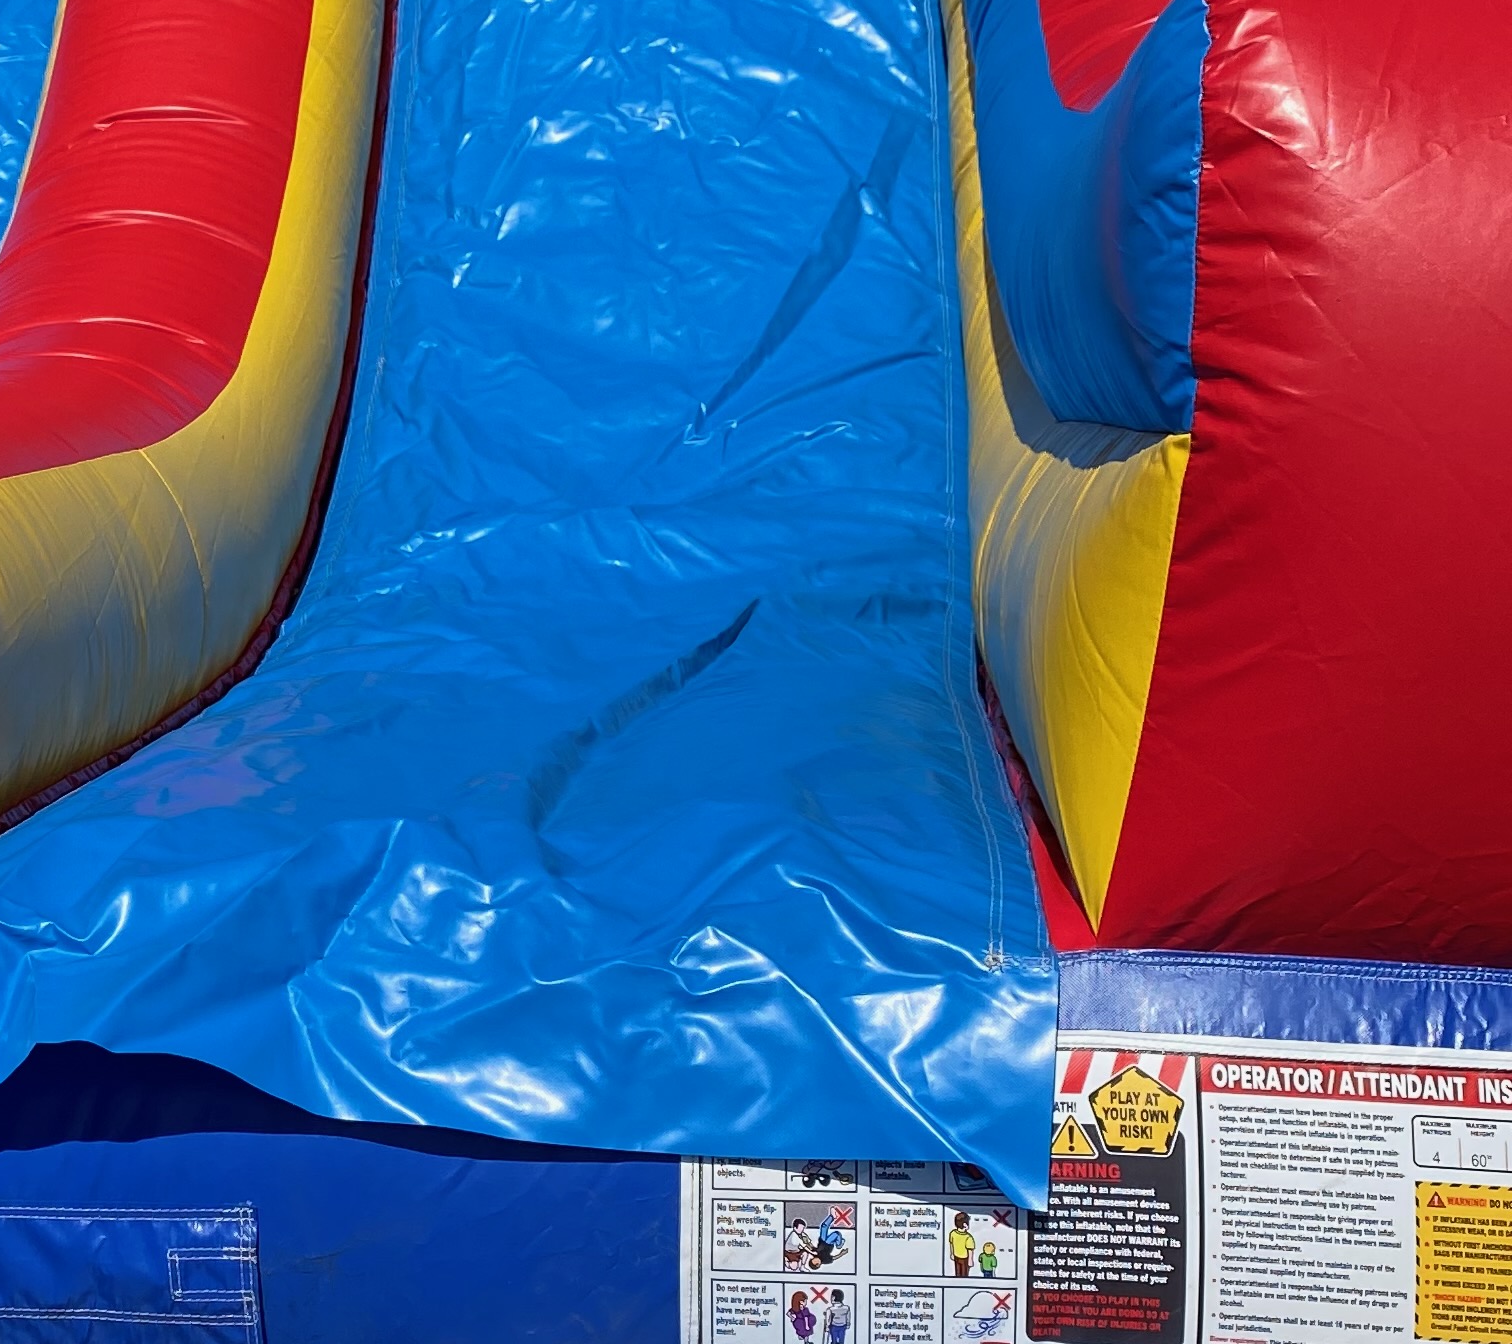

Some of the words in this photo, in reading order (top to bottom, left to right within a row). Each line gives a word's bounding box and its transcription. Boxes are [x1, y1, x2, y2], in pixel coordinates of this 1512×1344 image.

[1211, 1063, 1323, 1093] OPERATOR
[1340, 1070, 1466, 1101] ATTENDANT
[1110, 1091, 1140, 1105] PLAY
[1145, 1094, 1160, 1106] AT
[1054, 1102, 1077, 1112] ATH!
[1102, 1108, 1137, 1121] YOUR
[1141, 1109, 1169, 1123] OWN
[1120, 1125, 1153, 1139] RISK!
[1433, 1152, 1440, 1163] 4
[1051, 1162, 1121, 1178] ARNING
[1052, 1184, 1088, 1193] inflatable
[1089, 1185, 1097, 1193] is
[1109, 1186, 1155, 1195] amusement
[717, 1203, 727, 1211] No
[1063, 1197, 1080, 1205] With
[1082, 1197, 1092, 1206] all
[1093, 1198, 1138, 1207] amusement
[1139, 1199, 1169, 1209] devices
[887, 1207, 911, 1217] mixing
[1070, 1209, 1102, 1218] inherent
[1134, 1214, 1149, 1222] you
[1150, 1213, 1178, 1222] choose
[1059, 1221, 1074, 1230] this
[1115, 1223, 1133, 1232] note
[1134, 1224, 1151, 1233] that
[1152, 1225, 1165, 1233] the
[758, 1228, 776, 1238] piling
[1034, 1232, 1085, 1243] manufacturer
[1086, 1235, 1108, 1244] DOES
[1109, 1236, 1126, 1244] NOT
[1128, 1237, 1167, 1246] WARRANT
[1169, 1238, 1180, 1247] its
[1034, 1245, 1057, 1256] safety
[1068, 1246, 1113, 1258] compliance
[1114, 1248, 1132, 1257] with
[1067, 1258, 1086, 1267] local
[1087, 1259, 1132, 1271] inspections
[1033, 1269, 1057, 1278] ments
[1058, 1270, 1070, 1278] for
[1071, 1270, 1095, 1281] safety
[1096, 1271, 1105, 1280] at
[1106, 1272, 1119, 1280] the
[1120, 1272, 1138, 1281] time
[1139, 1273, 1148, 1282] of
[1149, 1275, 1167, 1284] your
[741, 1284, 759, 1292] enter
[1033, 1280, 1058, 1289] choice
[1060, 1281, 1068, 1290] of
[1070, 1282, 1080, 1290] its
[875, 1289, 898, 1298] During
[900, 1290, 935, 1298] inclement
[716, 1297, 729, 1305] you
[875, 1300, 904, 1308] weather
[716, 1306, 733, 1314] have
[875, 1311, 908, 1319] inflatable
[910, 1312, 934, 1321] begins
[716, 1317, 745, 1327] physical
[913, 1322, 928, 1332] stop
[875, 1332, 900, 1341] playing
